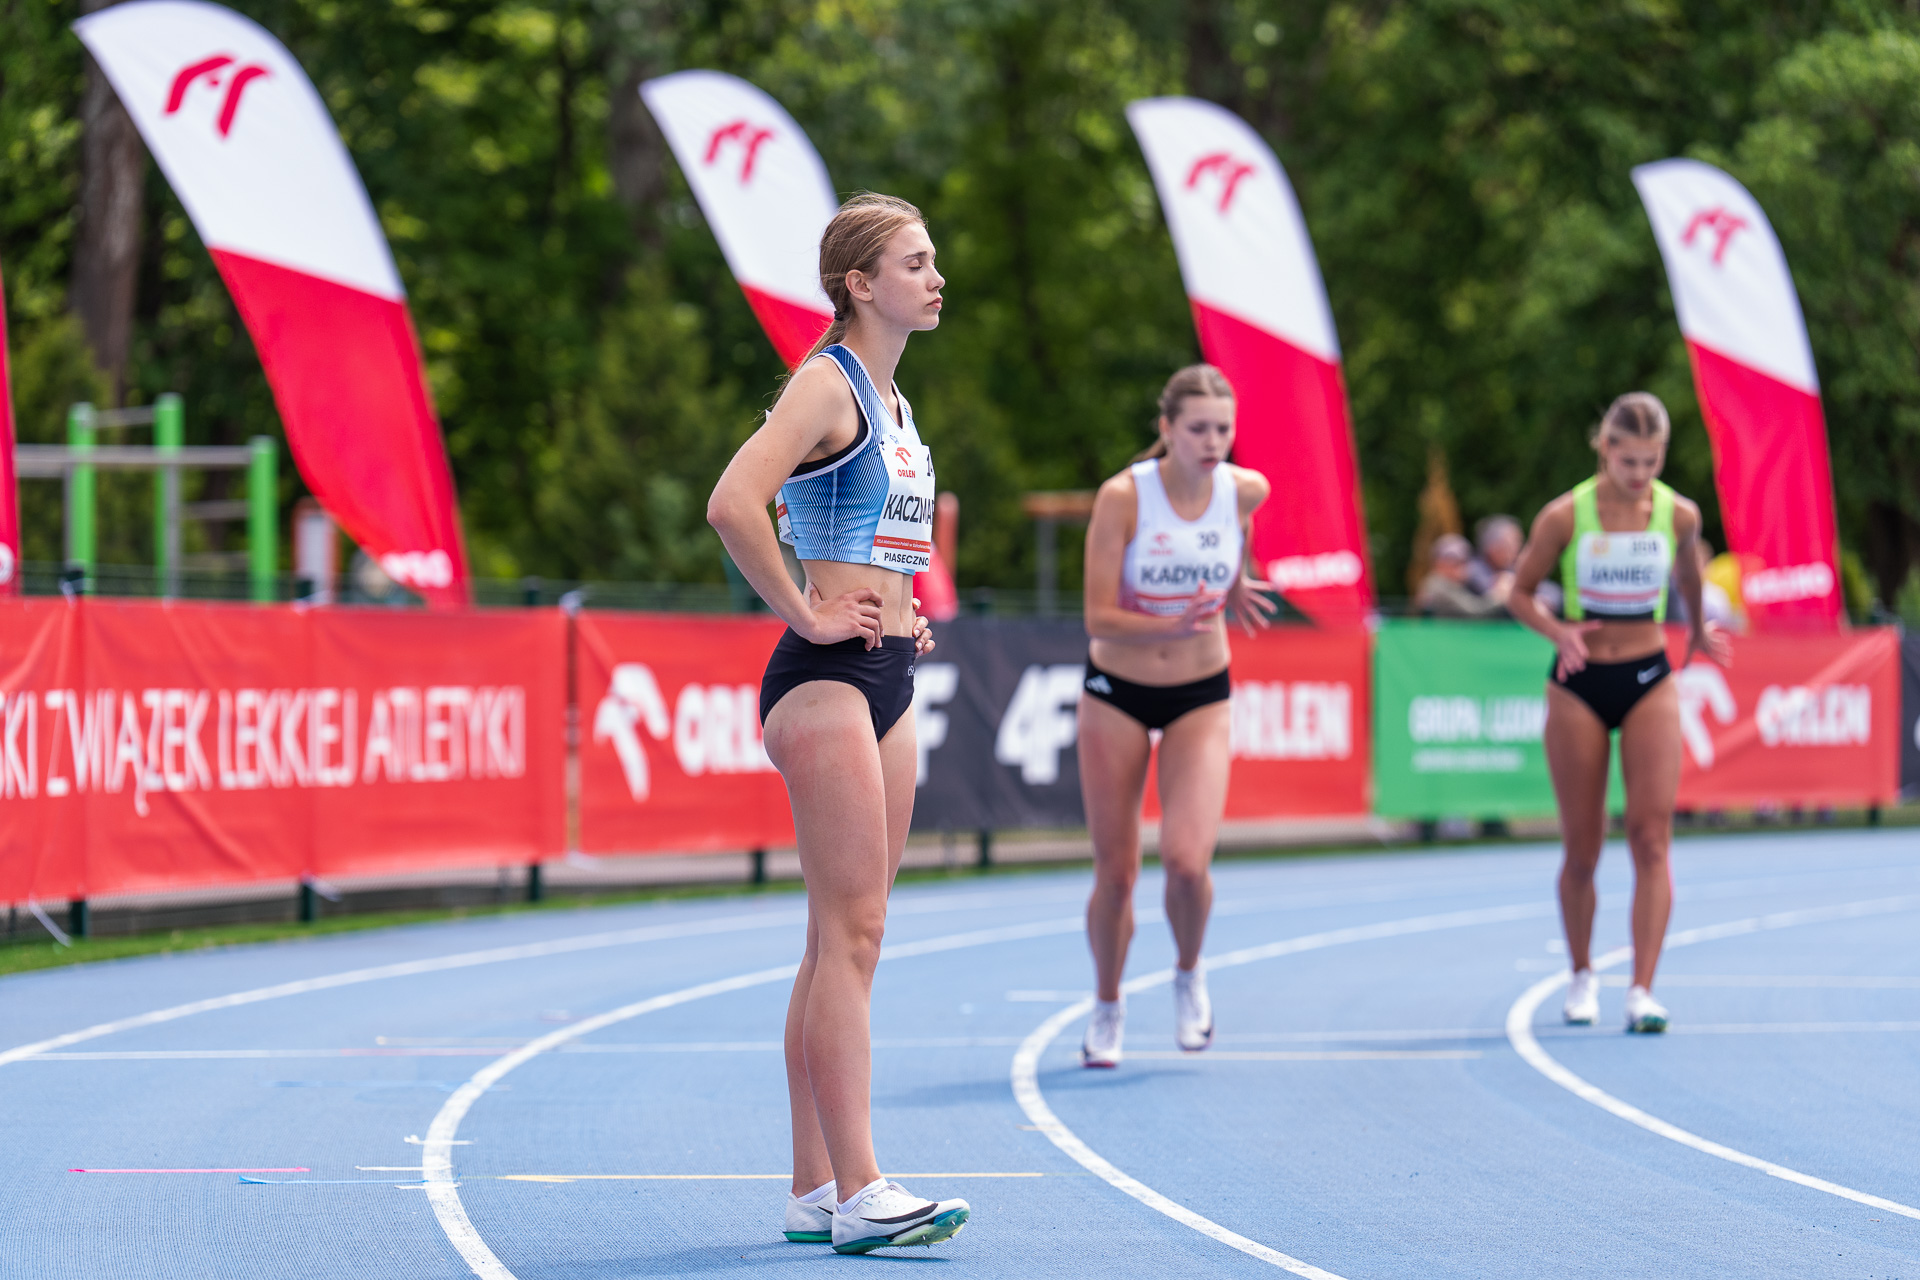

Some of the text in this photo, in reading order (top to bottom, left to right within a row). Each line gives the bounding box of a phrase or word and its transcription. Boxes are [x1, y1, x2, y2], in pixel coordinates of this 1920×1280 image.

[897, 469, 916, 479] ORLEN
[884, 552, 930, 567] PIASECZNO
[1141, 562, 1230, 584] KADYŁO
[1590, 565, 1656, 585] JANIEC
[674, 682, 779, 776] ORL
[994, 663, 1086, 786] 4F
[1755, 684, 1871, 747] ORLEN
[0, 690, 38, 800] KI
[217, 687, 359, 791] LEKKIEJ
[362, 685, 526, 785] ATLETYKI
